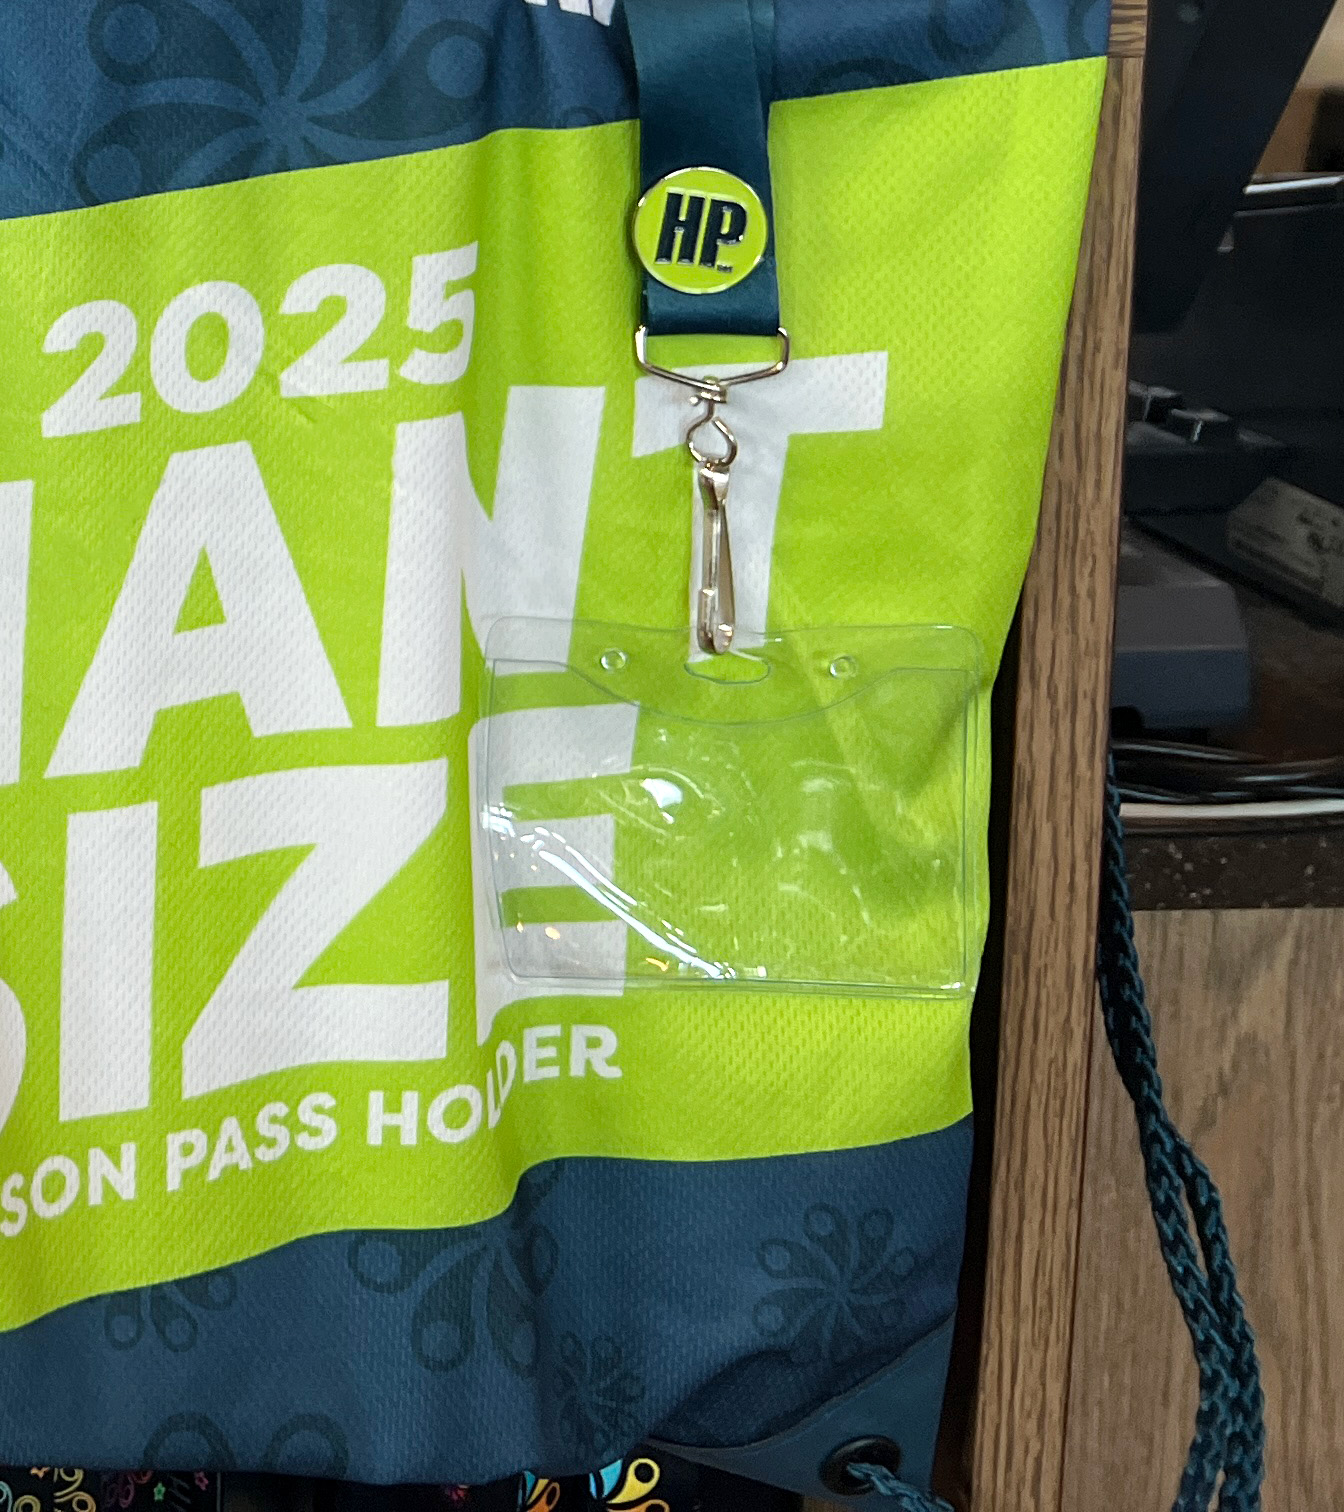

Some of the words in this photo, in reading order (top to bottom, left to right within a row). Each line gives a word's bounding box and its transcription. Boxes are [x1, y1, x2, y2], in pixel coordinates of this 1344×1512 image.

[653, 188, 749, 270] HP
[40, 239, 480, 439] 2025
[163, 1089, 340, 1193] PASS
[366, 1023, 623, 1148] HOLDER
